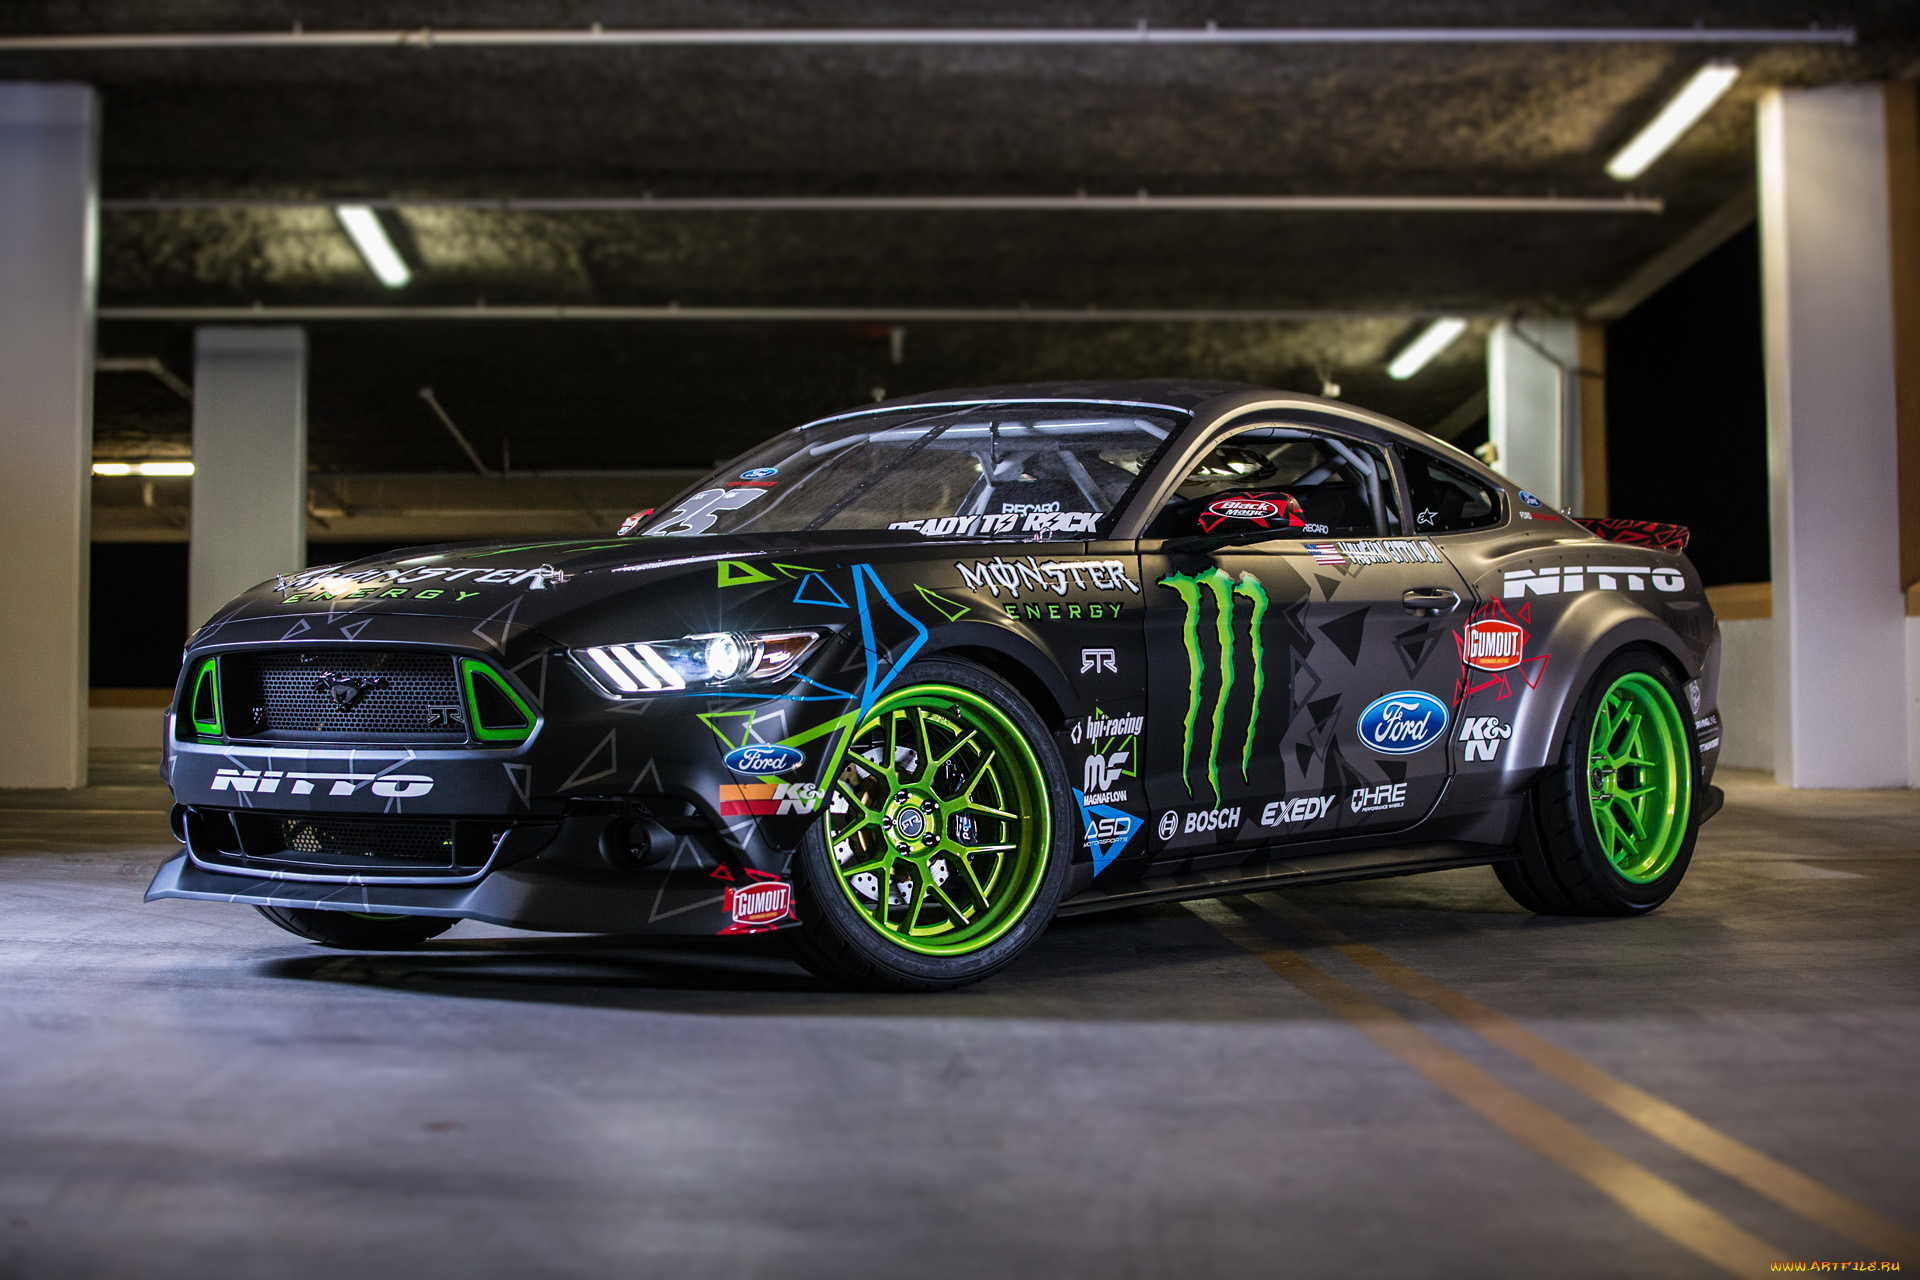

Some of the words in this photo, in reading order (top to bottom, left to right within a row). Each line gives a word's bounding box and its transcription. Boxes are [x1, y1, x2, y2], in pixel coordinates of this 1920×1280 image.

[1221, 501, 1271, 511] Black
[1225, 509, 1267, 517] Magic
[980, 513, 1018, 535] TO
[1021, 512, 1104, 533] ROCK
[1303, 523, 1329, 535] RECARO
[1382, 540, 1427, 563] GITTIN
[1418, 540, 1442, 563] JR
[955, 556, 1140, 599] MONSTER
[1503, 565, 1686, 598] NITTO
[281, 587, 481, 605] ENERGY
[1005, 604, 1122, 620] ENERGY
[1468, 629, 1519, 658] GUMOUT
[739, 748, 787, 770] Ford
[210, 768, 434, 797] NITTO
[1083, 790, 1127, 807] MAGNAFLOW
[1363, 783, 1408, 806] HRE
[1184, 807, 1241, 834] BOSCH
[1261, 795, 1336, 827] EXEDY
[1084, 816, 1131, 840] ASD
[1083, 836, 1129, 848] MOTORSPORTS
[738, 889, 787, 917] GUMOUT
